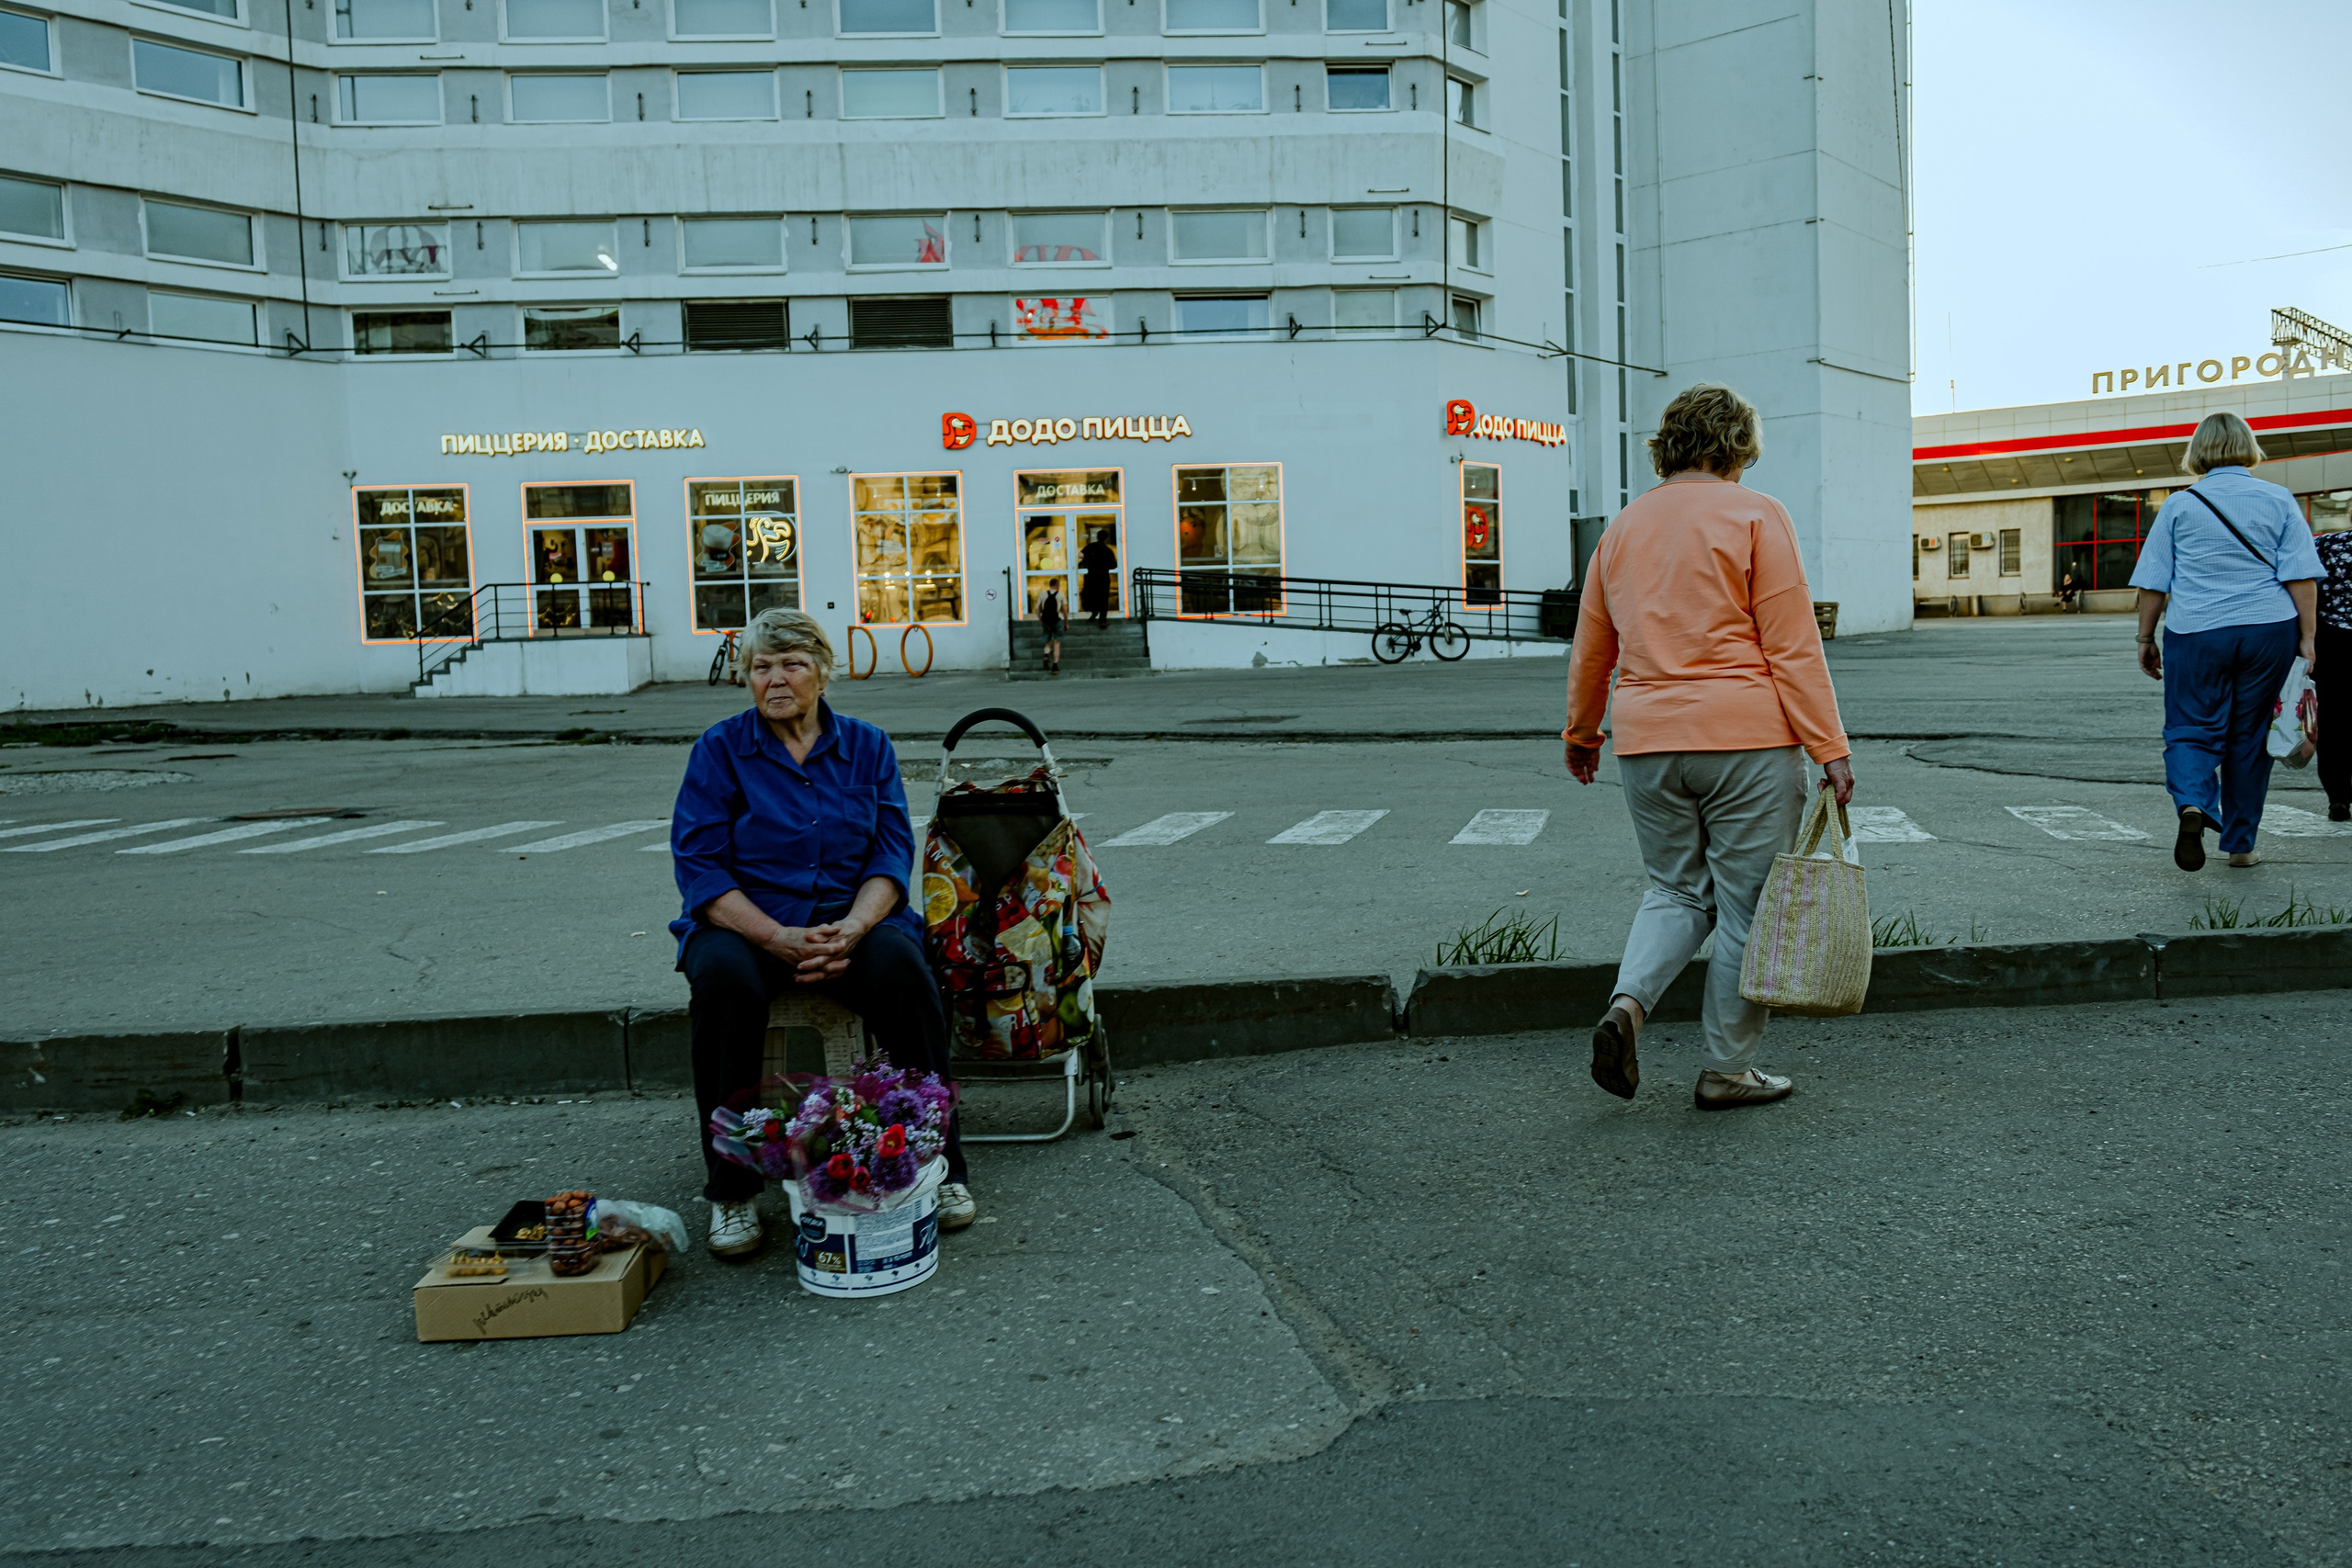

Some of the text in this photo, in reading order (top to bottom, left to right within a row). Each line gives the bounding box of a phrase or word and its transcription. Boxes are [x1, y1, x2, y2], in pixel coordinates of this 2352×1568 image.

[987, 414, 1193, 447] ДОДО ПИЦЦА
[1514, 418, 1567, 447] ПИЦЦА
[440, 428, 706, 457] ПИЦЦЕРИЯ ДОСТАВКА
[1035, 484, 1105, 499] ДОСТАВКА
[379, 501, 455, 516] ДОСАВКА
[818, 1251, 842, 1265] 67%
